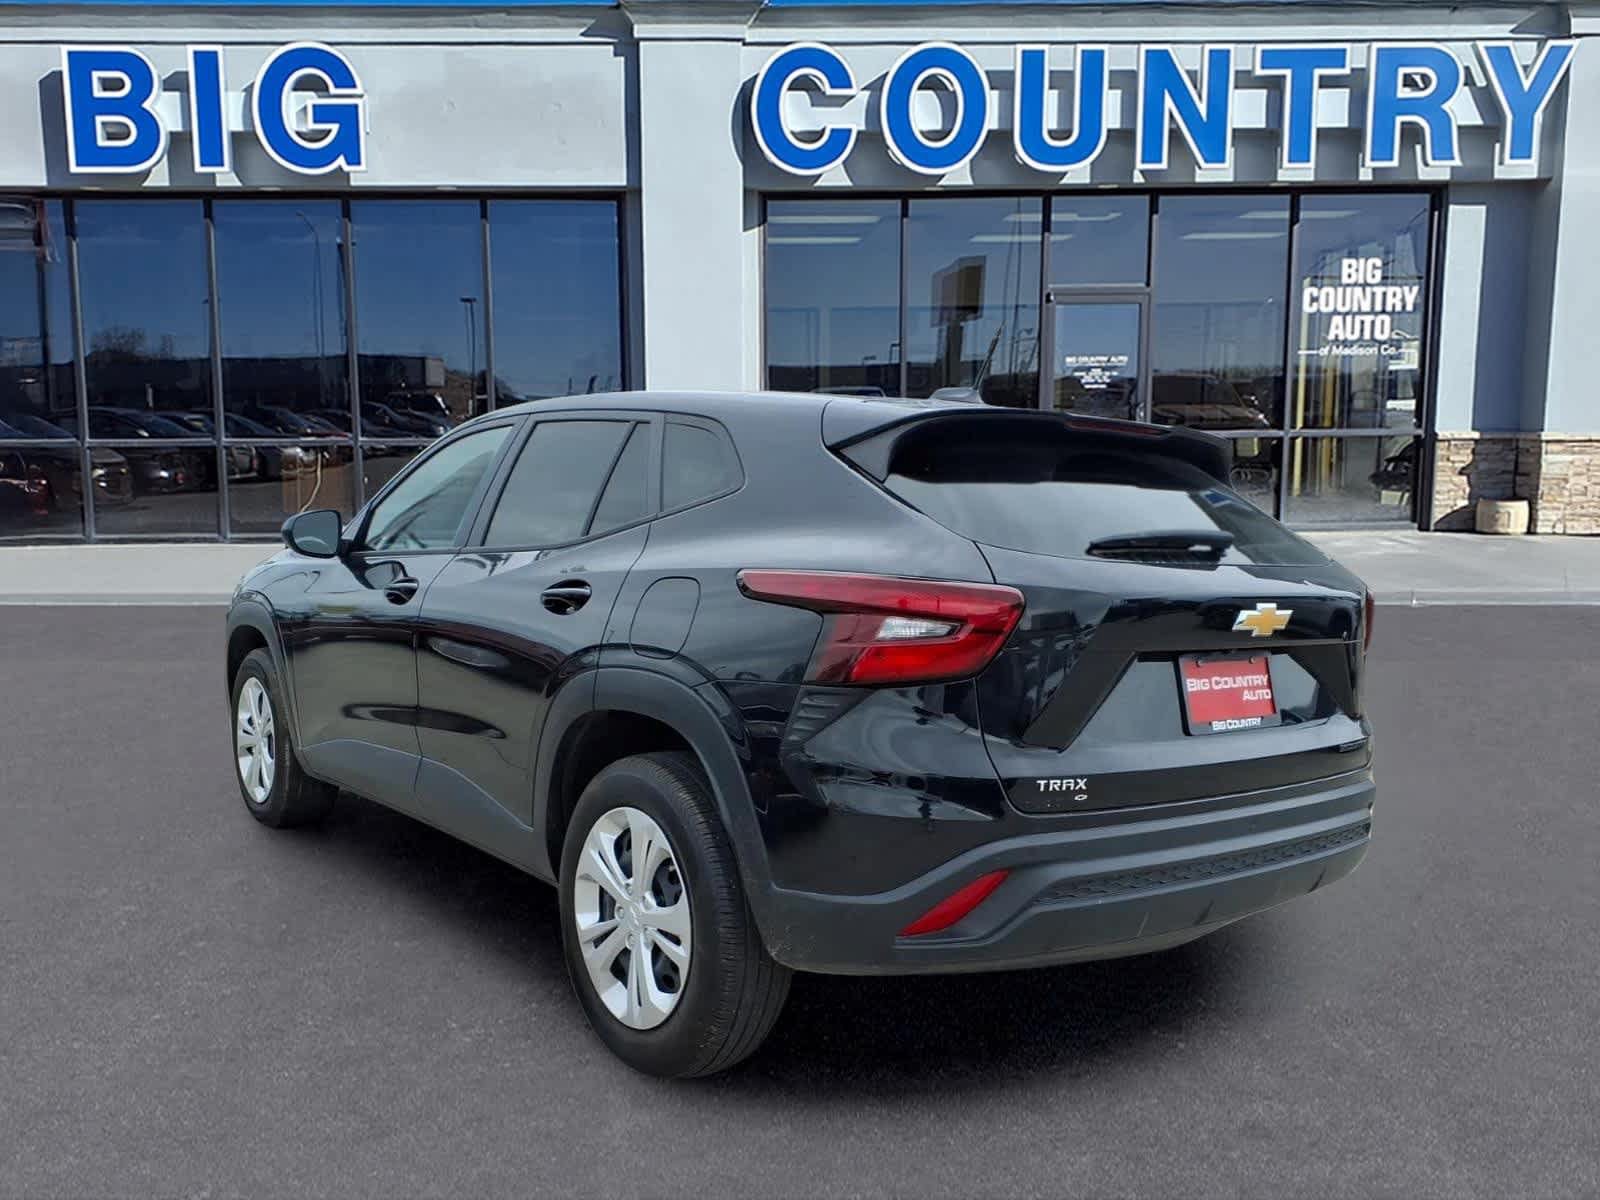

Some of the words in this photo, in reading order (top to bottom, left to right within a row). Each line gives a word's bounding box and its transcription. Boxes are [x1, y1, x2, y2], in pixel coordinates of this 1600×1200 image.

[61, 42, 368, 175] BIG
[751, 41, 1574, 175] COUNTRY
[1341, 257, 1383, 285] BIG
[1302, 286, 1419, 313] COUNTRY
[1327, 314, 1392, 341] AUTO
[1331, 344, 1379, 356] Madison
[1186, 677, 1210, 692] BIG
[1211, 674, 1269, 690] COUNTRY
[1242, 689, 1272, 701] AUTO
[1211, 720, 1226, 731] BIG
[1227, 717, 1262, 729] COUNTRY
[1036, 778, 1088, 792] TRAX
